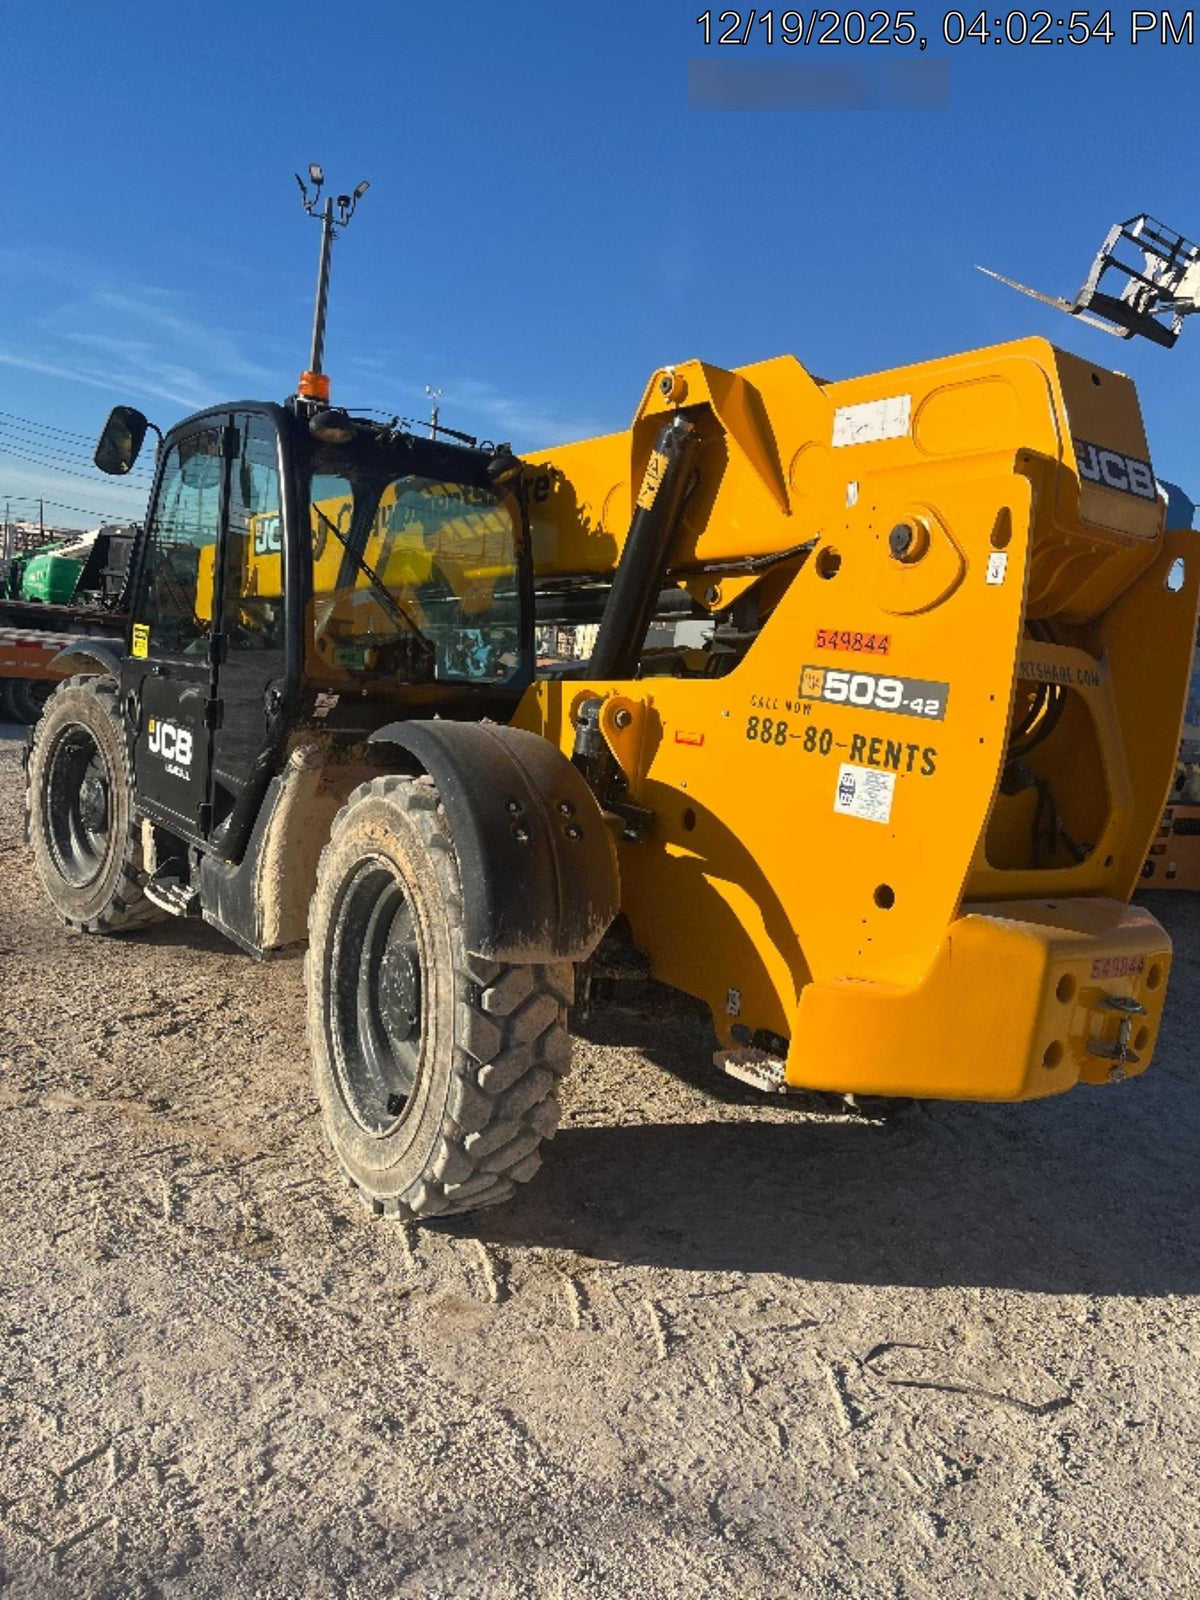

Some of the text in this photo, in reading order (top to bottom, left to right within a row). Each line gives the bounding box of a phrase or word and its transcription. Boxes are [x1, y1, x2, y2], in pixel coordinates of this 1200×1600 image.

[1078, 445, 1155, 498] JCB
[816, 629, 889, 655] 549844
[751, 694, 812, 715] CALL NOW
[148, 720, 193, 765] JCB
[746, 715, 938, 776] 888-80-RENTS
